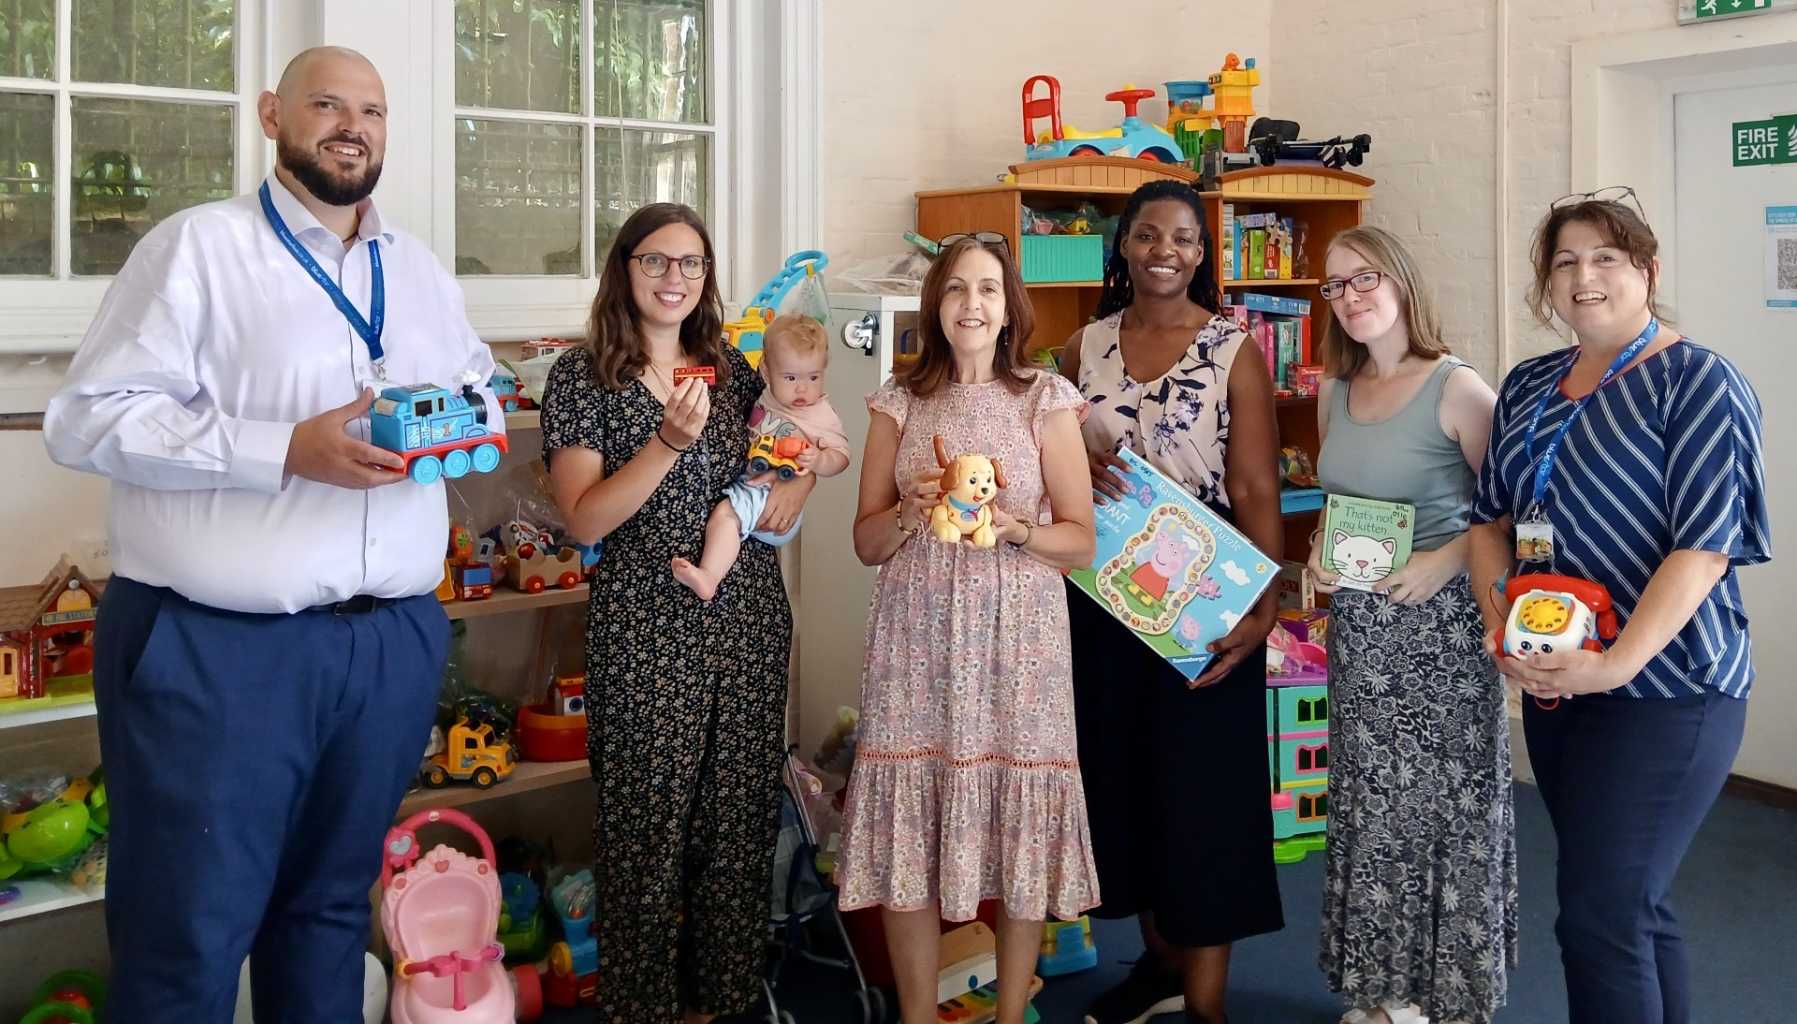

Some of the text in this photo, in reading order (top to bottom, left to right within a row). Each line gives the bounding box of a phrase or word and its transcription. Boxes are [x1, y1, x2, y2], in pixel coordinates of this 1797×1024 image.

[1737, 126, 1778, 144] FIRE
[1738, 143, 1778, 160] EXIT
[1340, 520, 1387, 535] my kitten
